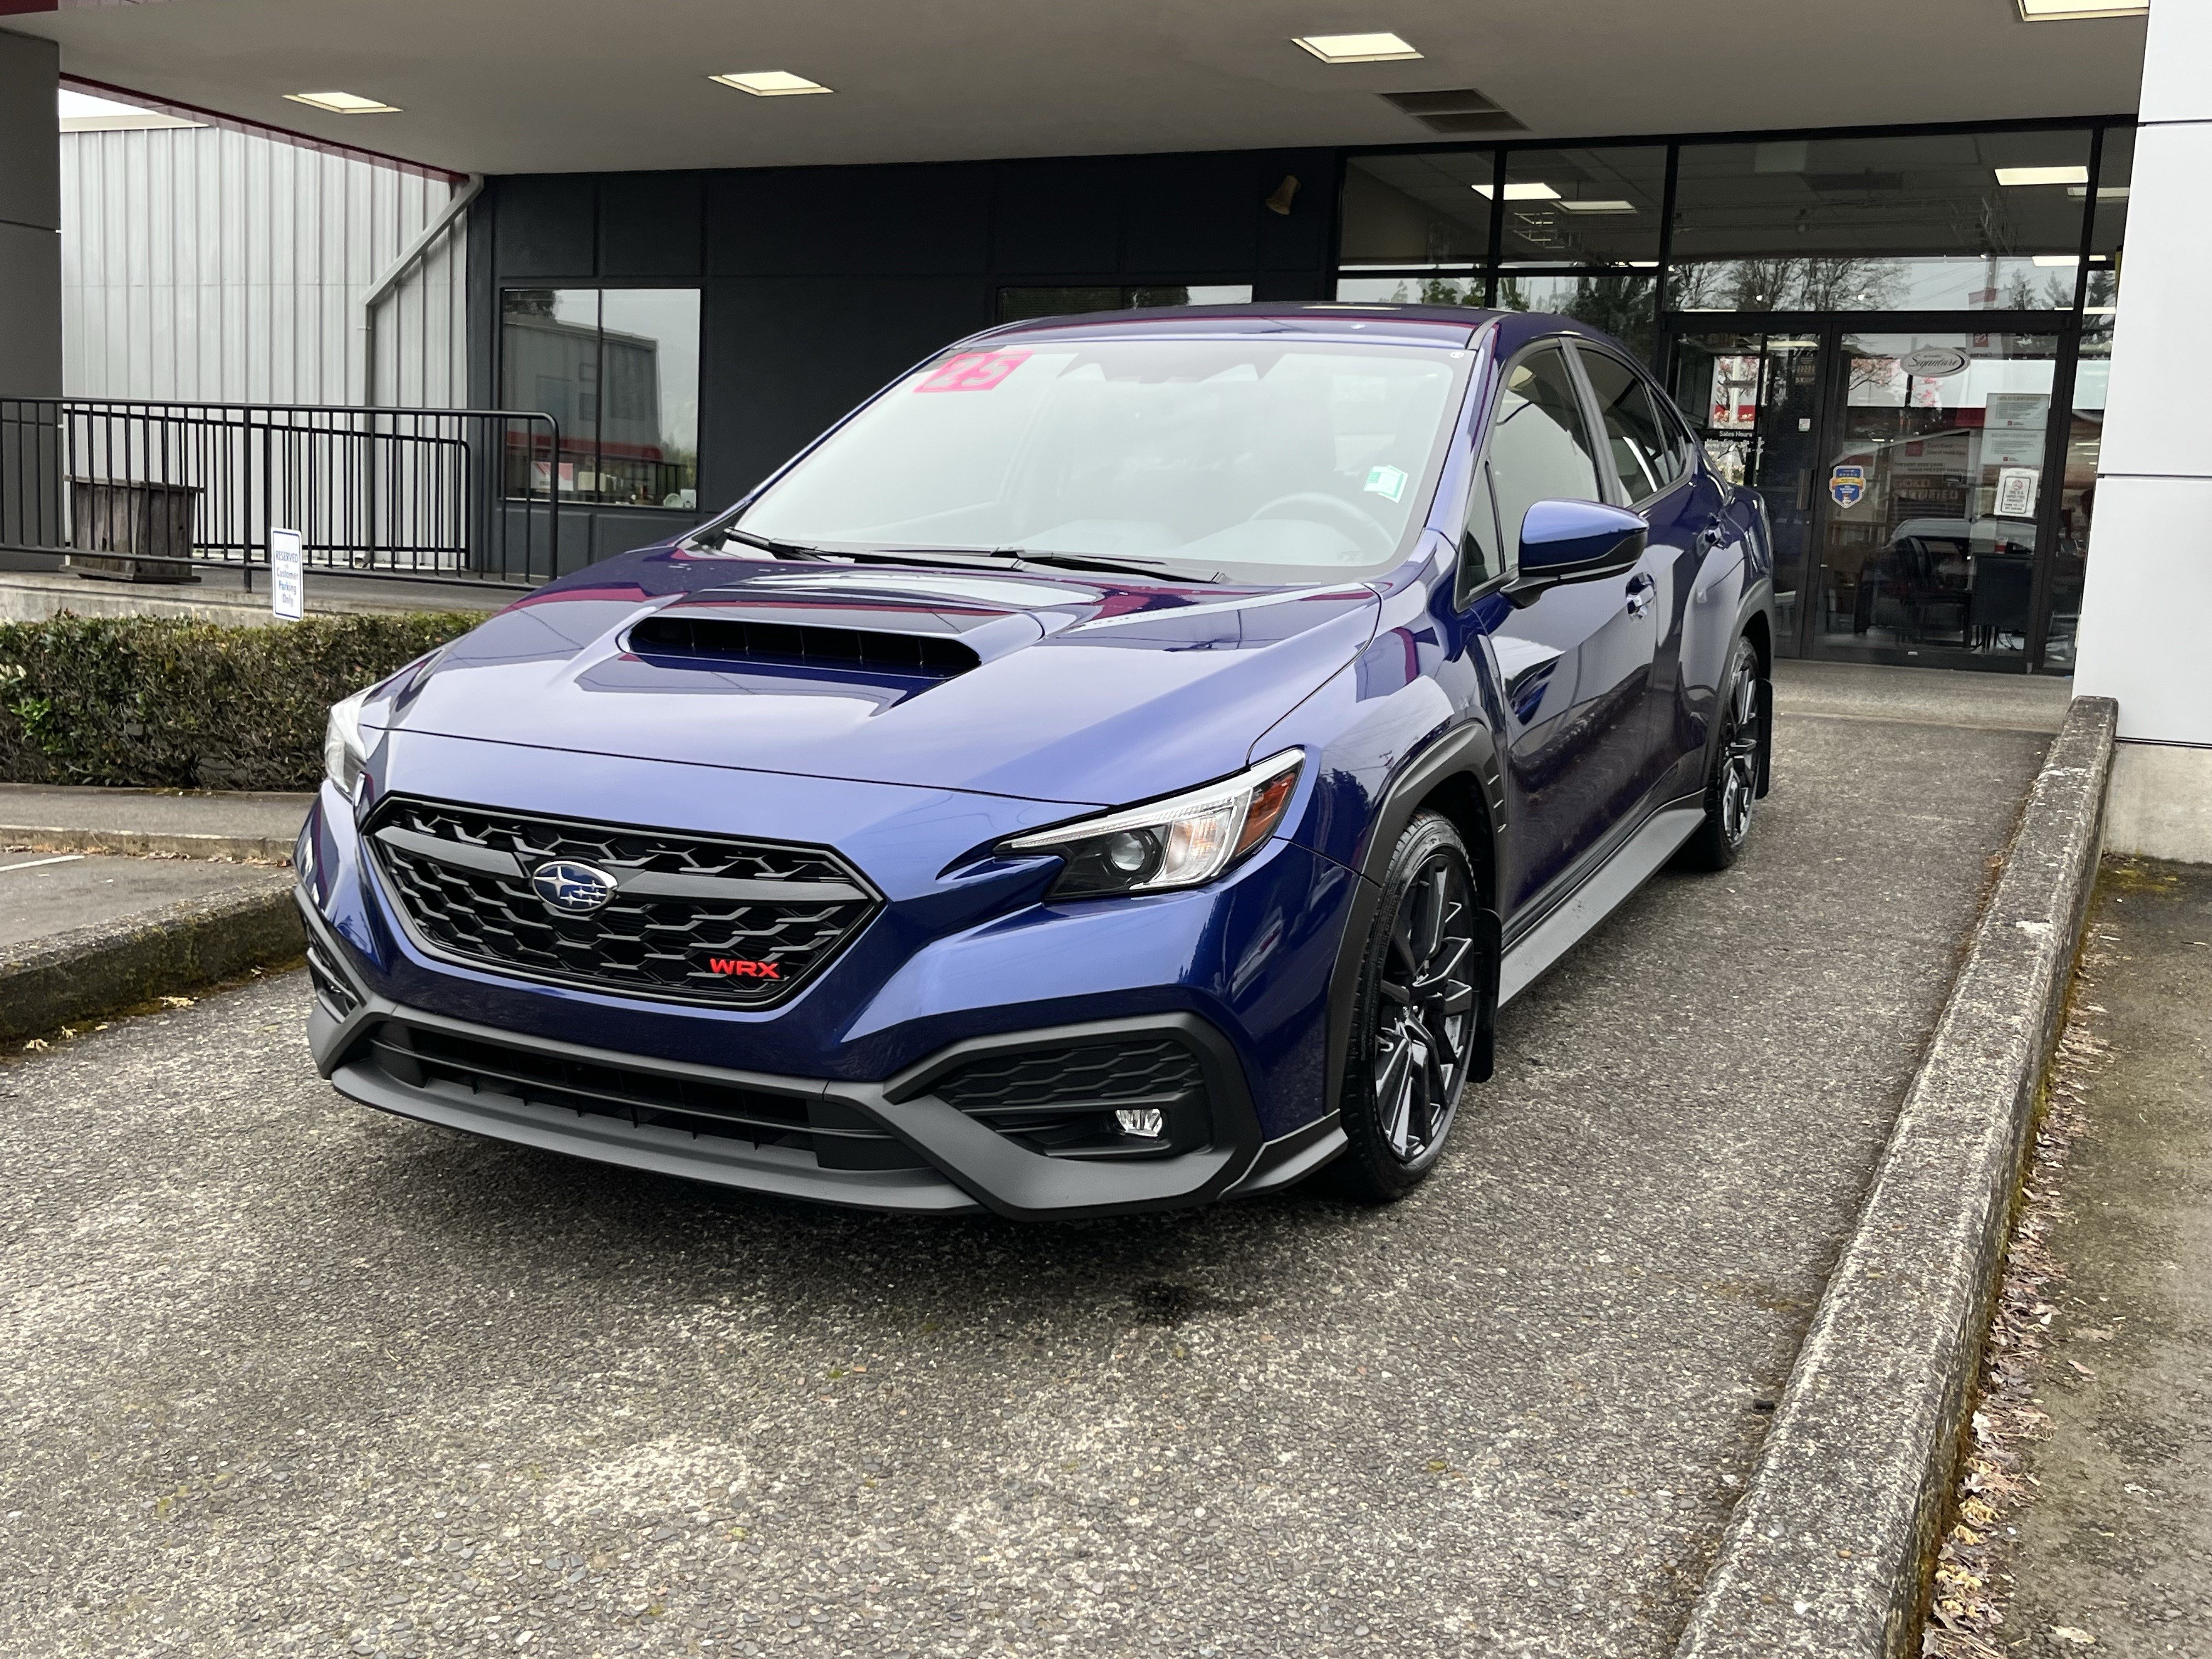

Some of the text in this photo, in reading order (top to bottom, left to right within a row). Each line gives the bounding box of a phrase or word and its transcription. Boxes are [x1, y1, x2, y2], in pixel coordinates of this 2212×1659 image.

[1908, 354, 1959, 372] Signature
[276, 550, 298, 563] RESERVED
[279, 580, 297, 595] Parking
[283, 594, 293, 607] Only
[710, 958, 780, 978] WRX
